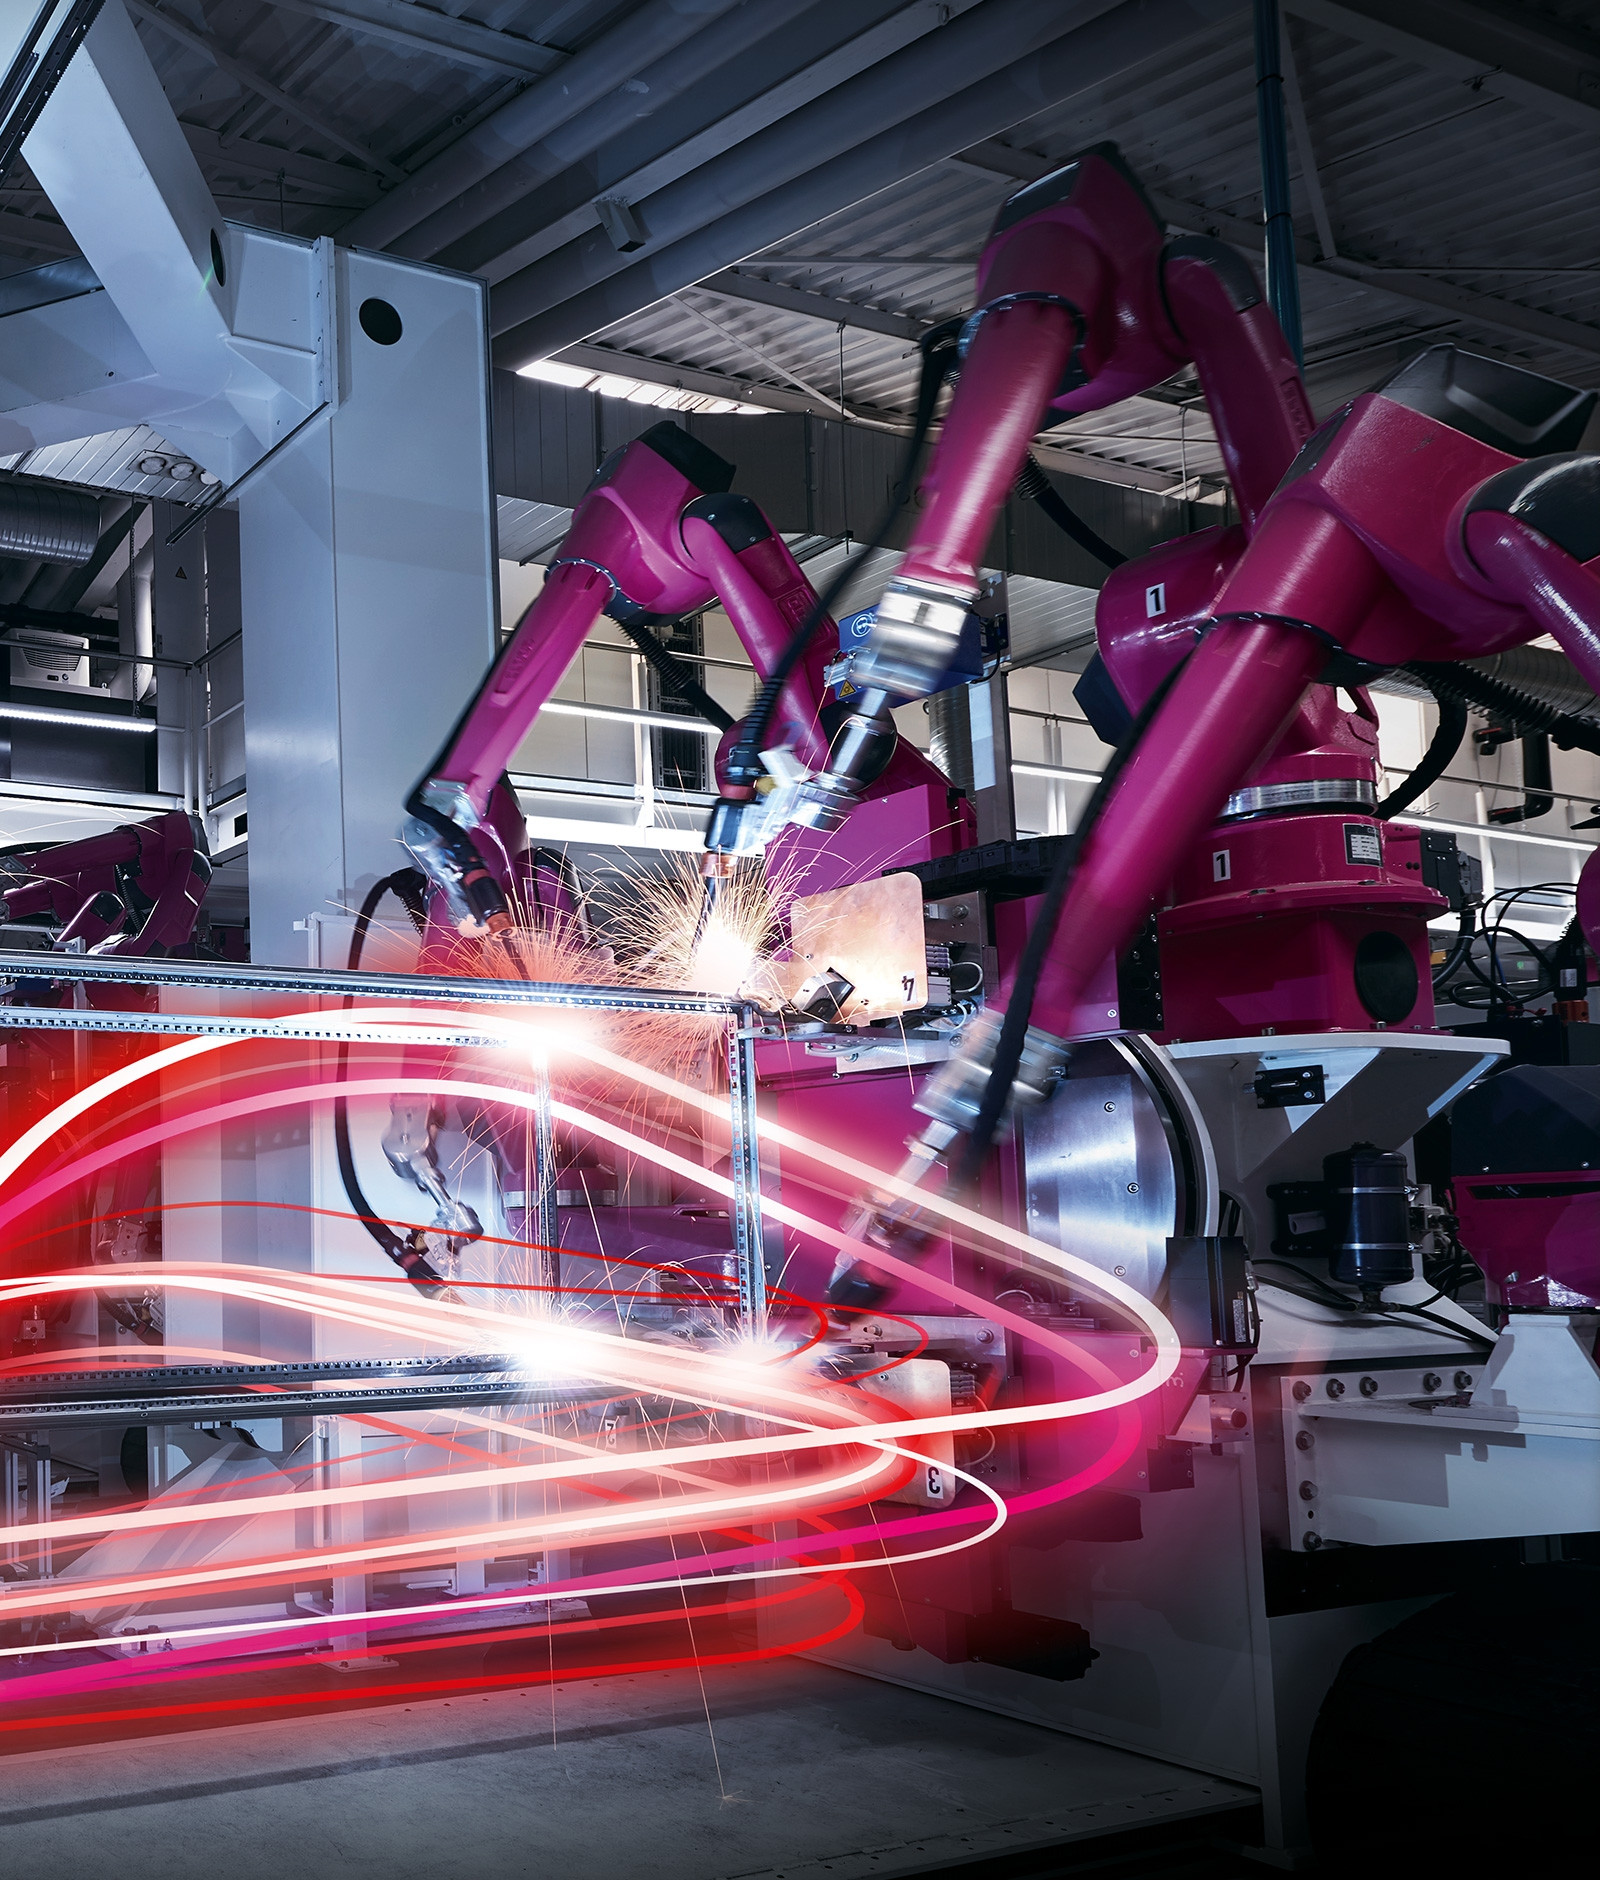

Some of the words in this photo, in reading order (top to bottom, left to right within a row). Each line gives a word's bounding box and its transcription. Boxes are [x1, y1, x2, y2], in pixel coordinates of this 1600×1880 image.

[1150, 587, 1162, 612] 1
[1216, 853, 1226, 878] 1
[901, 975, 915, 1002] 4
[928, 1466, 941, 1495] 3
